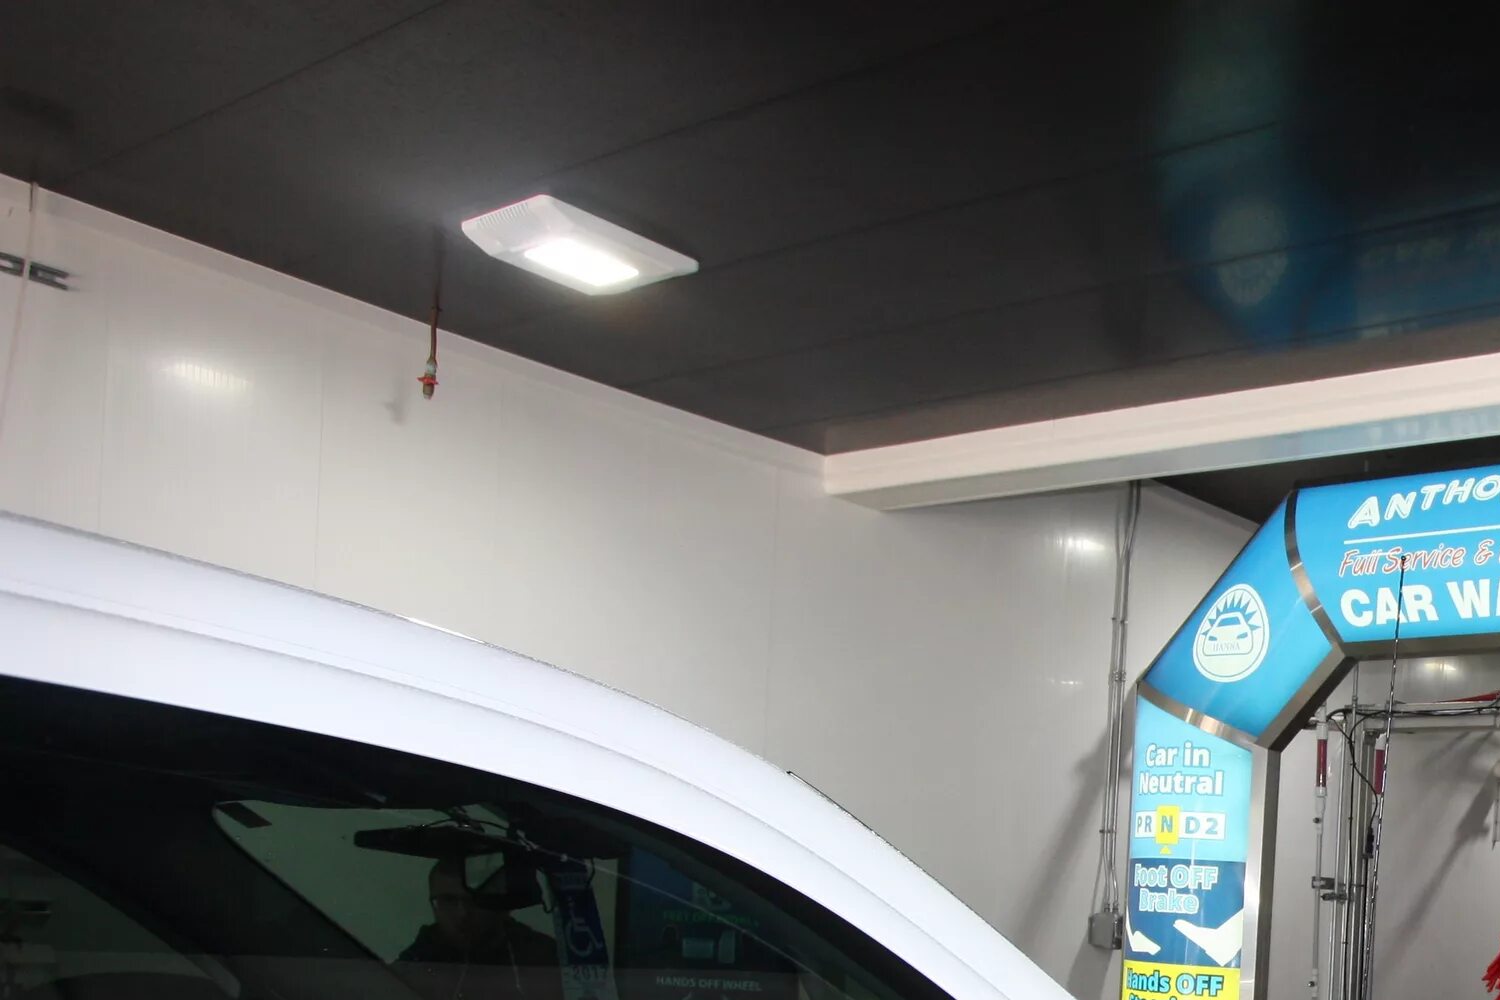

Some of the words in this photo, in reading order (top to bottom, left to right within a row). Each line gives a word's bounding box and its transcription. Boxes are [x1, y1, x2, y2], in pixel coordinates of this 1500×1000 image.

[1339, 548, 1379, 578] Full
[1382, 543, 1466, 574] Service
[1474, 540, 1494, 566] &
[1340, 584, 1440, 628] CAR
[1145, 743, 1179, 768] Car
[1183, 740, 1211, 768] in
[1139, 770, 1224, 796] Neutral
[1134, 864, 1167, 887] Foot
[1170, 865, 1219, 890] OFF
[1139, 888, 1200, 914] Brake
[656, 975, 695, 988] HANDS
[698, 978, 720, 989] OFF
[722, 978, 763, 992] WHEEL
[1126, 968, 1171, 993] Hands
[1176, 972, 1224, 997] OFF
